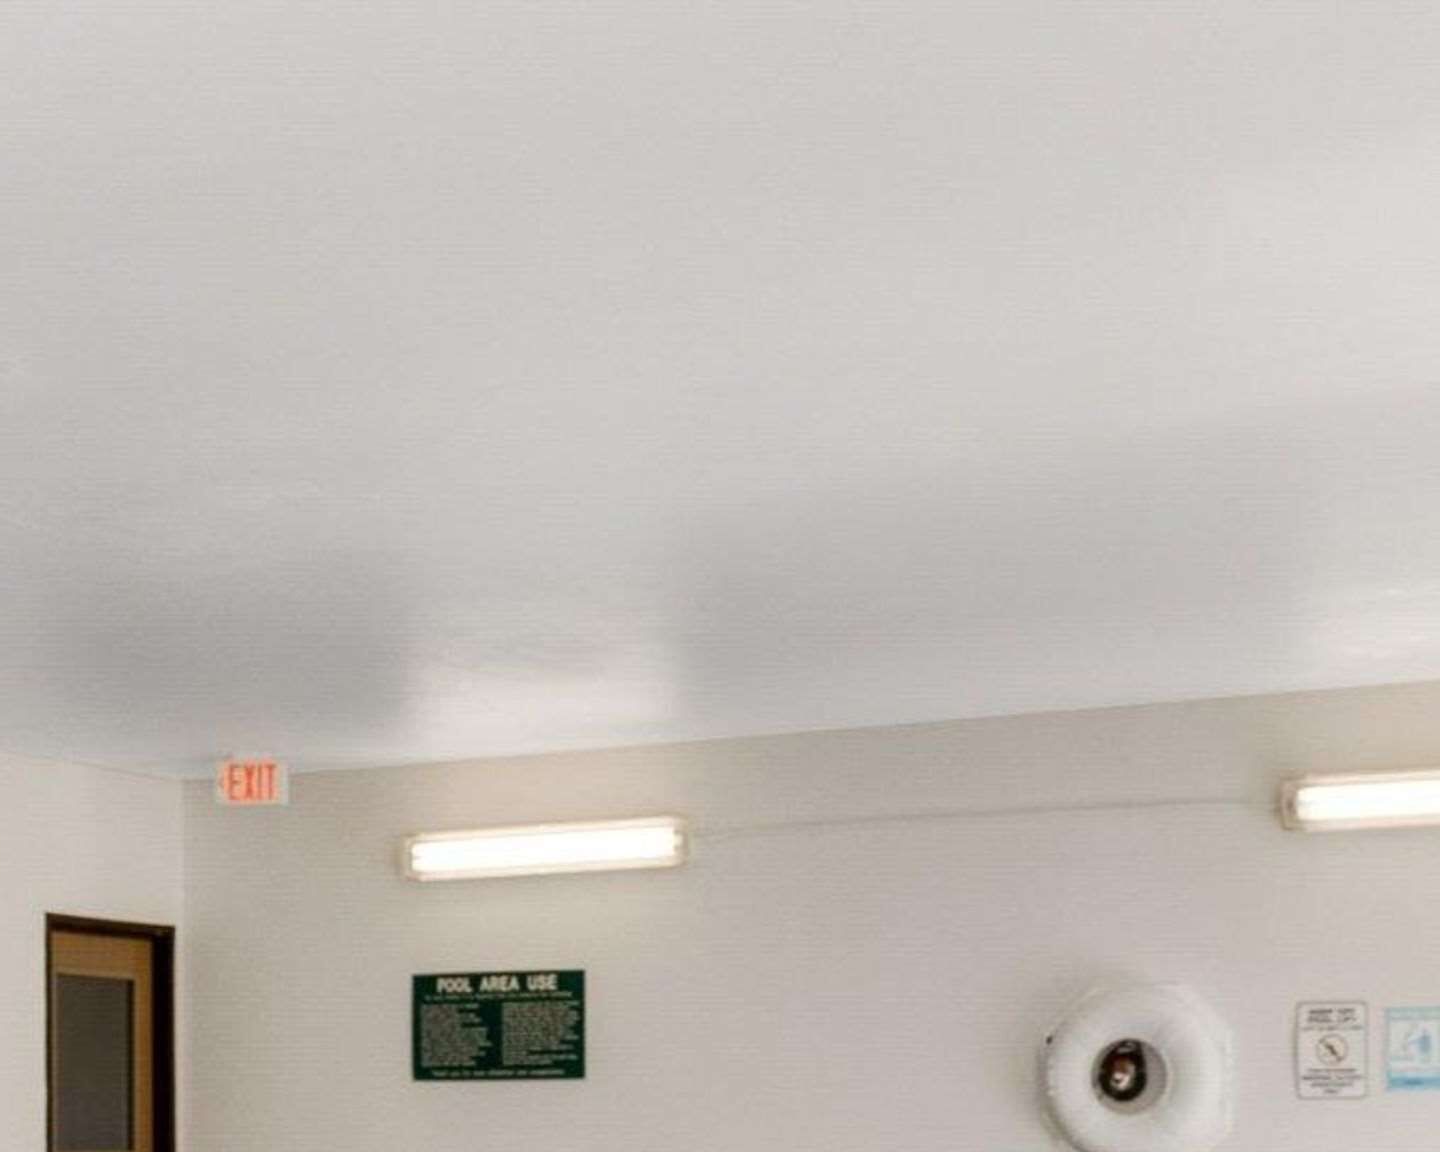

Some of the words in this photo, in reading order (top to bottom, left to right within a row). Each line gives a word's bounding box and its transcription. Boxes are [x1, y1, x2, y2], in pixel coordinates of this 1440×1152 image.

[228, 763, 277, 801] EXIT
[436, 977, 472, 992] POOL
[479, 975, 520, 991] AREA
[526, 974, 558, 990] USE
